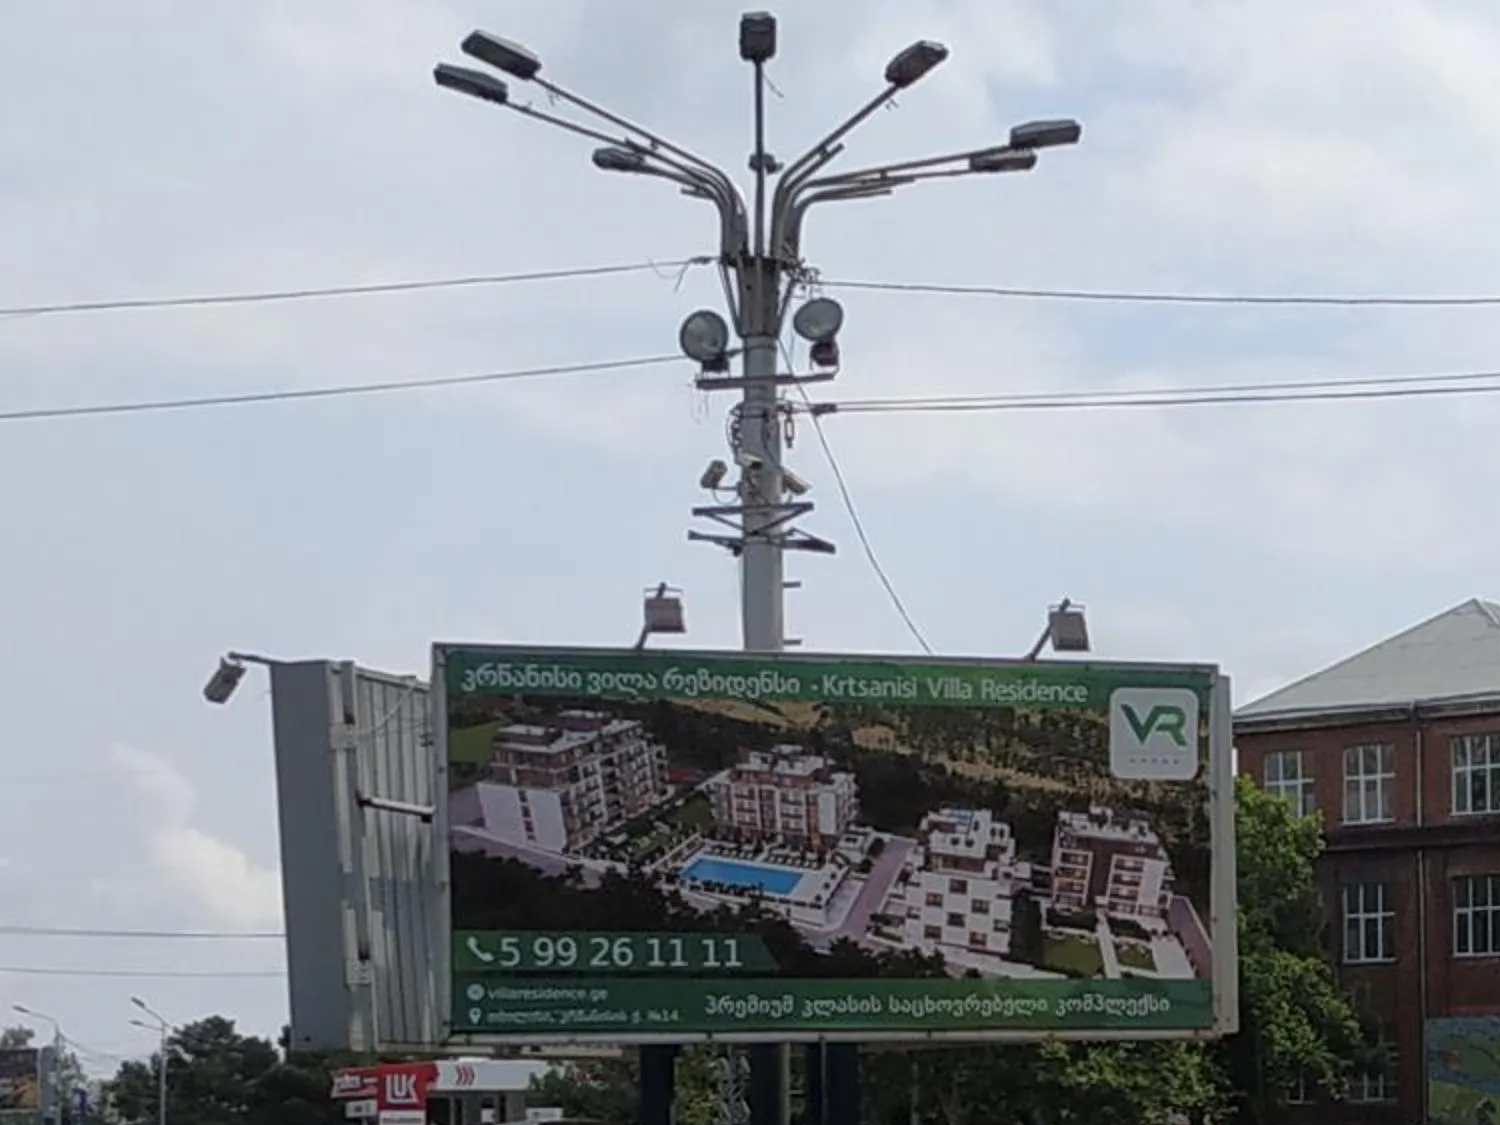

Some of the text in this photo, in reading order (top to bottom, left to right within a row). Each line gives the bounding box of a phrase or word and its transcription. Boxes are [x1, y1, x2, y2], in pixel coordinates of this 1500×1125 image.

[587, 670, 657, 695] ვილა
[662, 666, 801, 698] რეზიდენსი
[822, 675, 1088, 704] Krtsanisi Villa Residence
[1119, 703, 1189, 747] VR
[500, 937, 743, 968] 5 99 26 11 11
[704, 993, 1171, 1019] პრემიუმ კლასის საცხოვრებელი კომპლექსი
